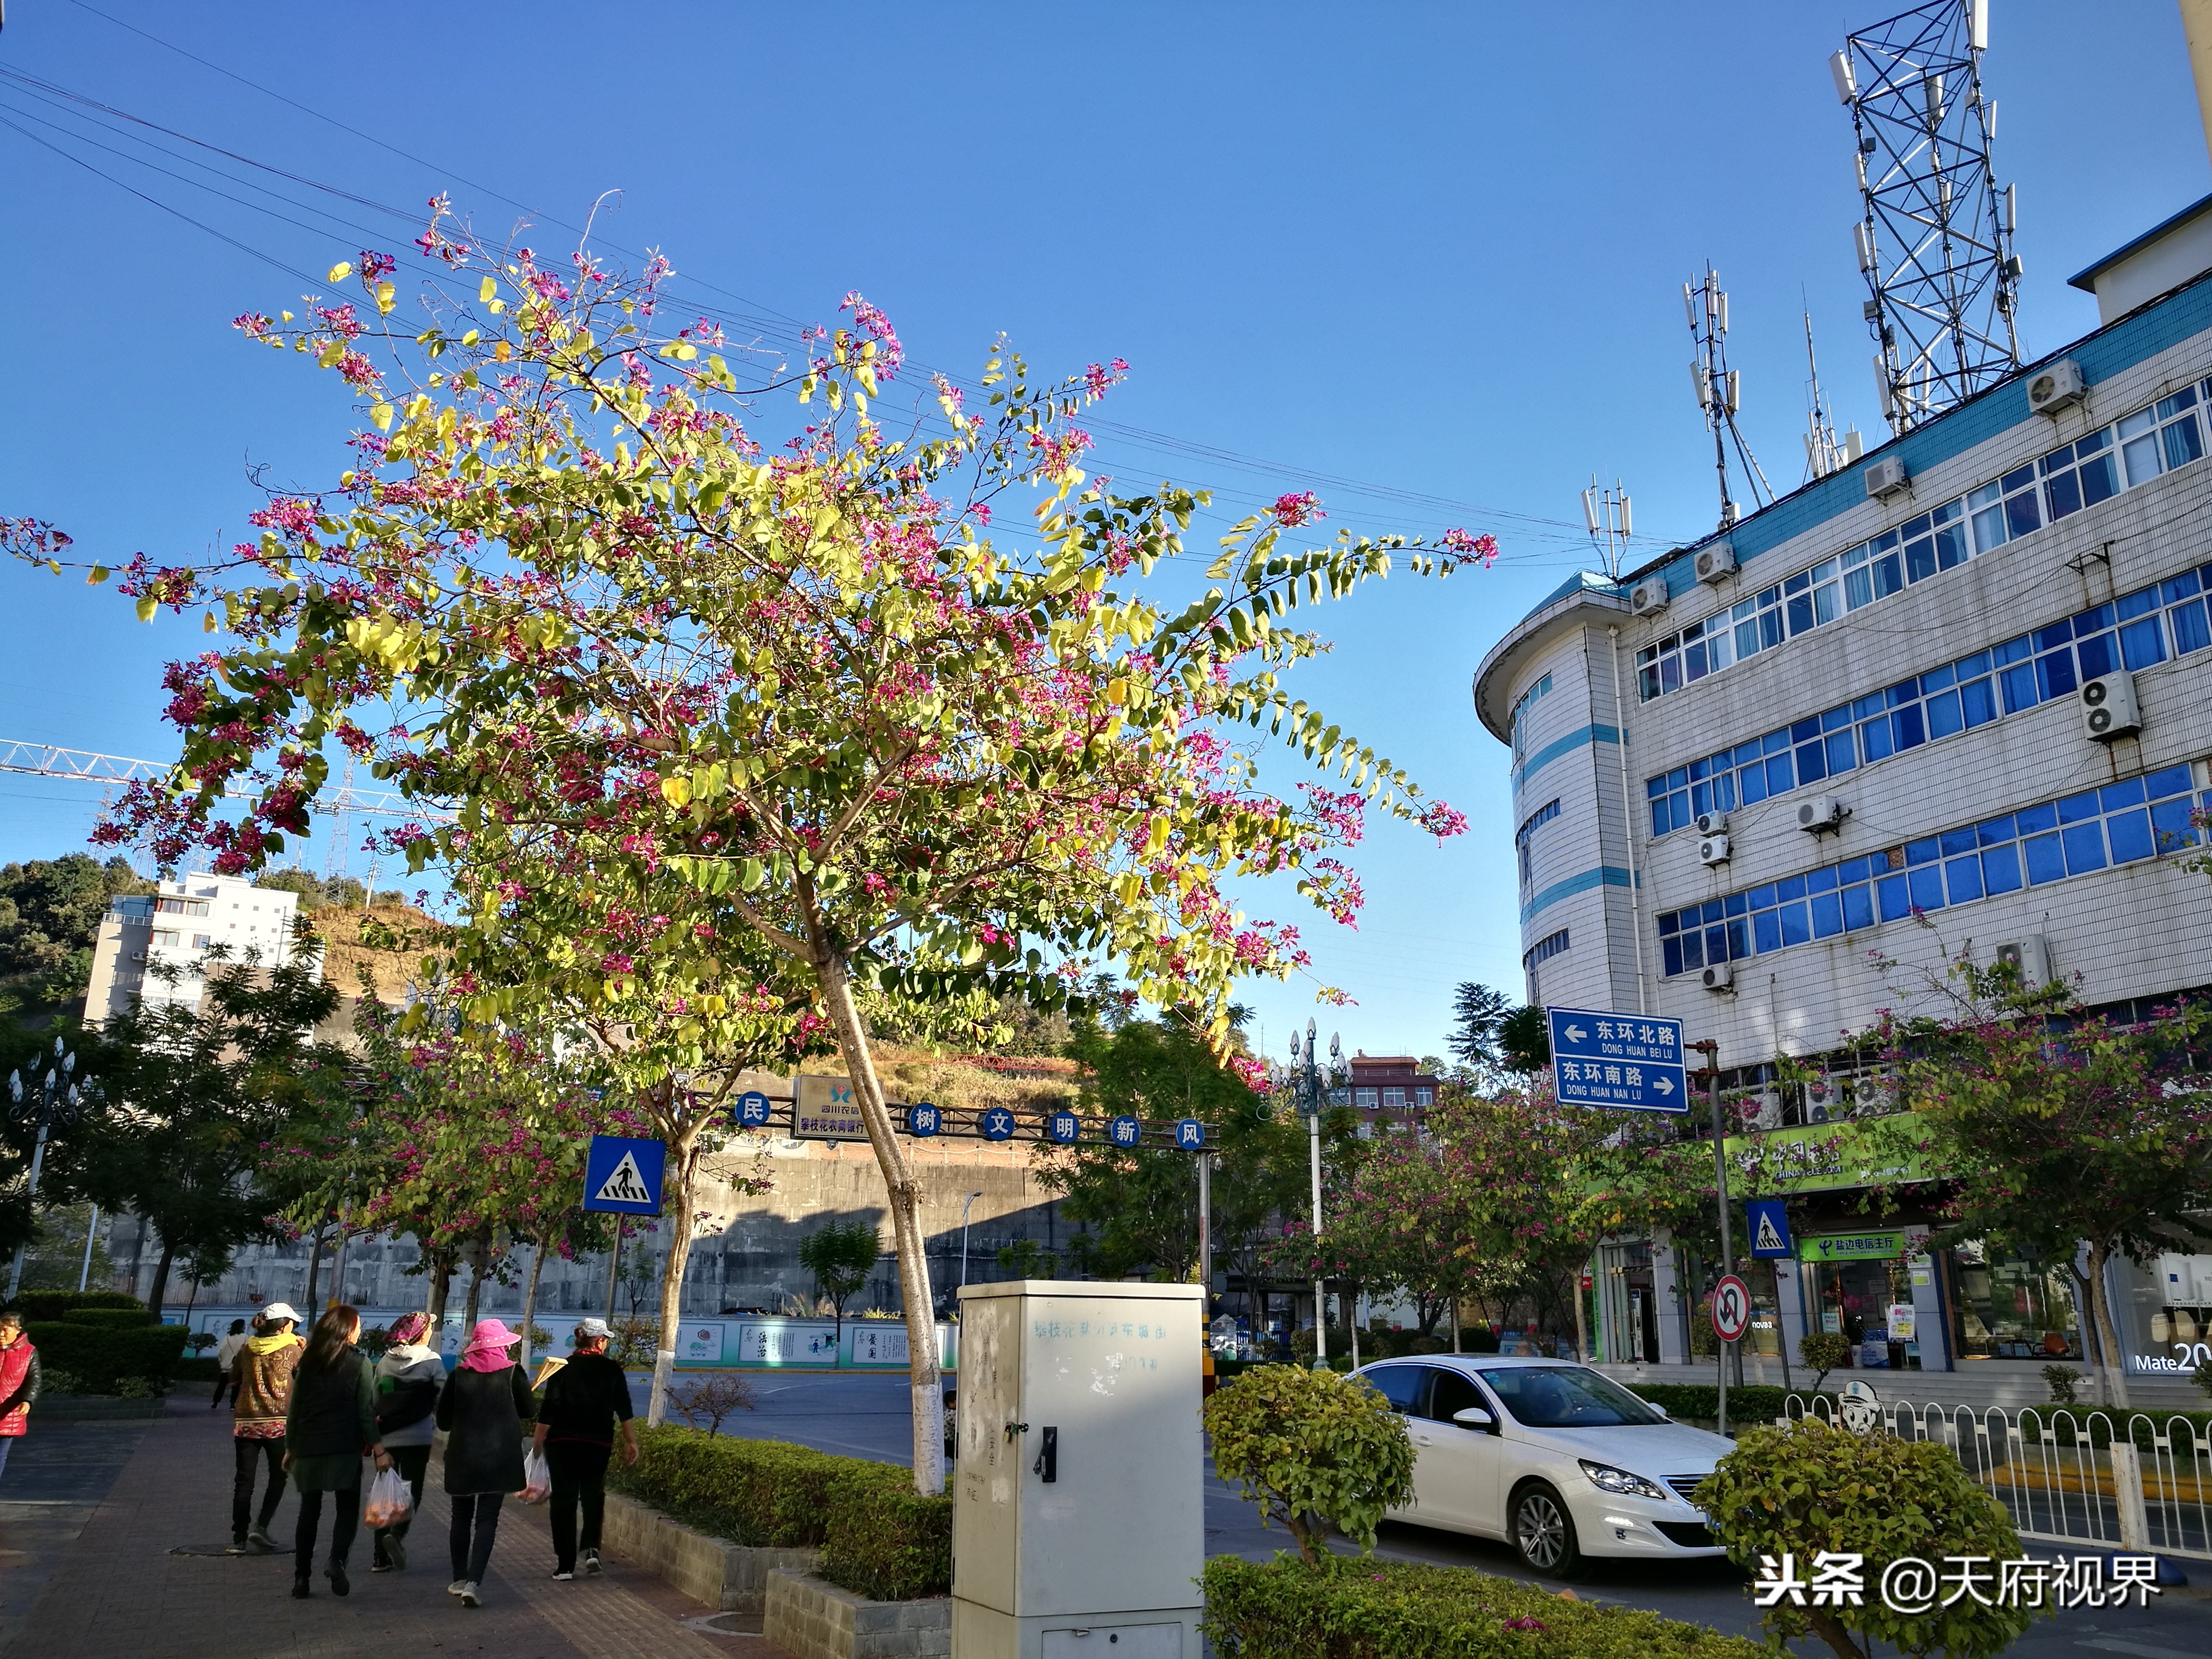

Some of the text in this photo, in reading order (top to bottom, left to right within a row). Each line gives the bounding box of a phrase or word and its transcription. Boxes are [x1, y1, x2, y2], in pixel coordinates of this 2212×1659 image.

[1596, 1021, 1675, 1046] 东环北路
[1602, 1043, 1672, 1059] DONG HUAN BEI LU
[1563, 1061, 1643, 1086] 东环南路
[1566, 1084, 1641, 1100] DONG HUAN NAN LU
[743, 1098, 764, 1120] 民
[822, 1105, 859, 1114] 四川农信
[801, 1117, 865, 1133] 攀枝花农商银行
[1835, 1237, 1894, 1250] 盐边电信主厅
[758, 1331, 768, 1357] 法治
